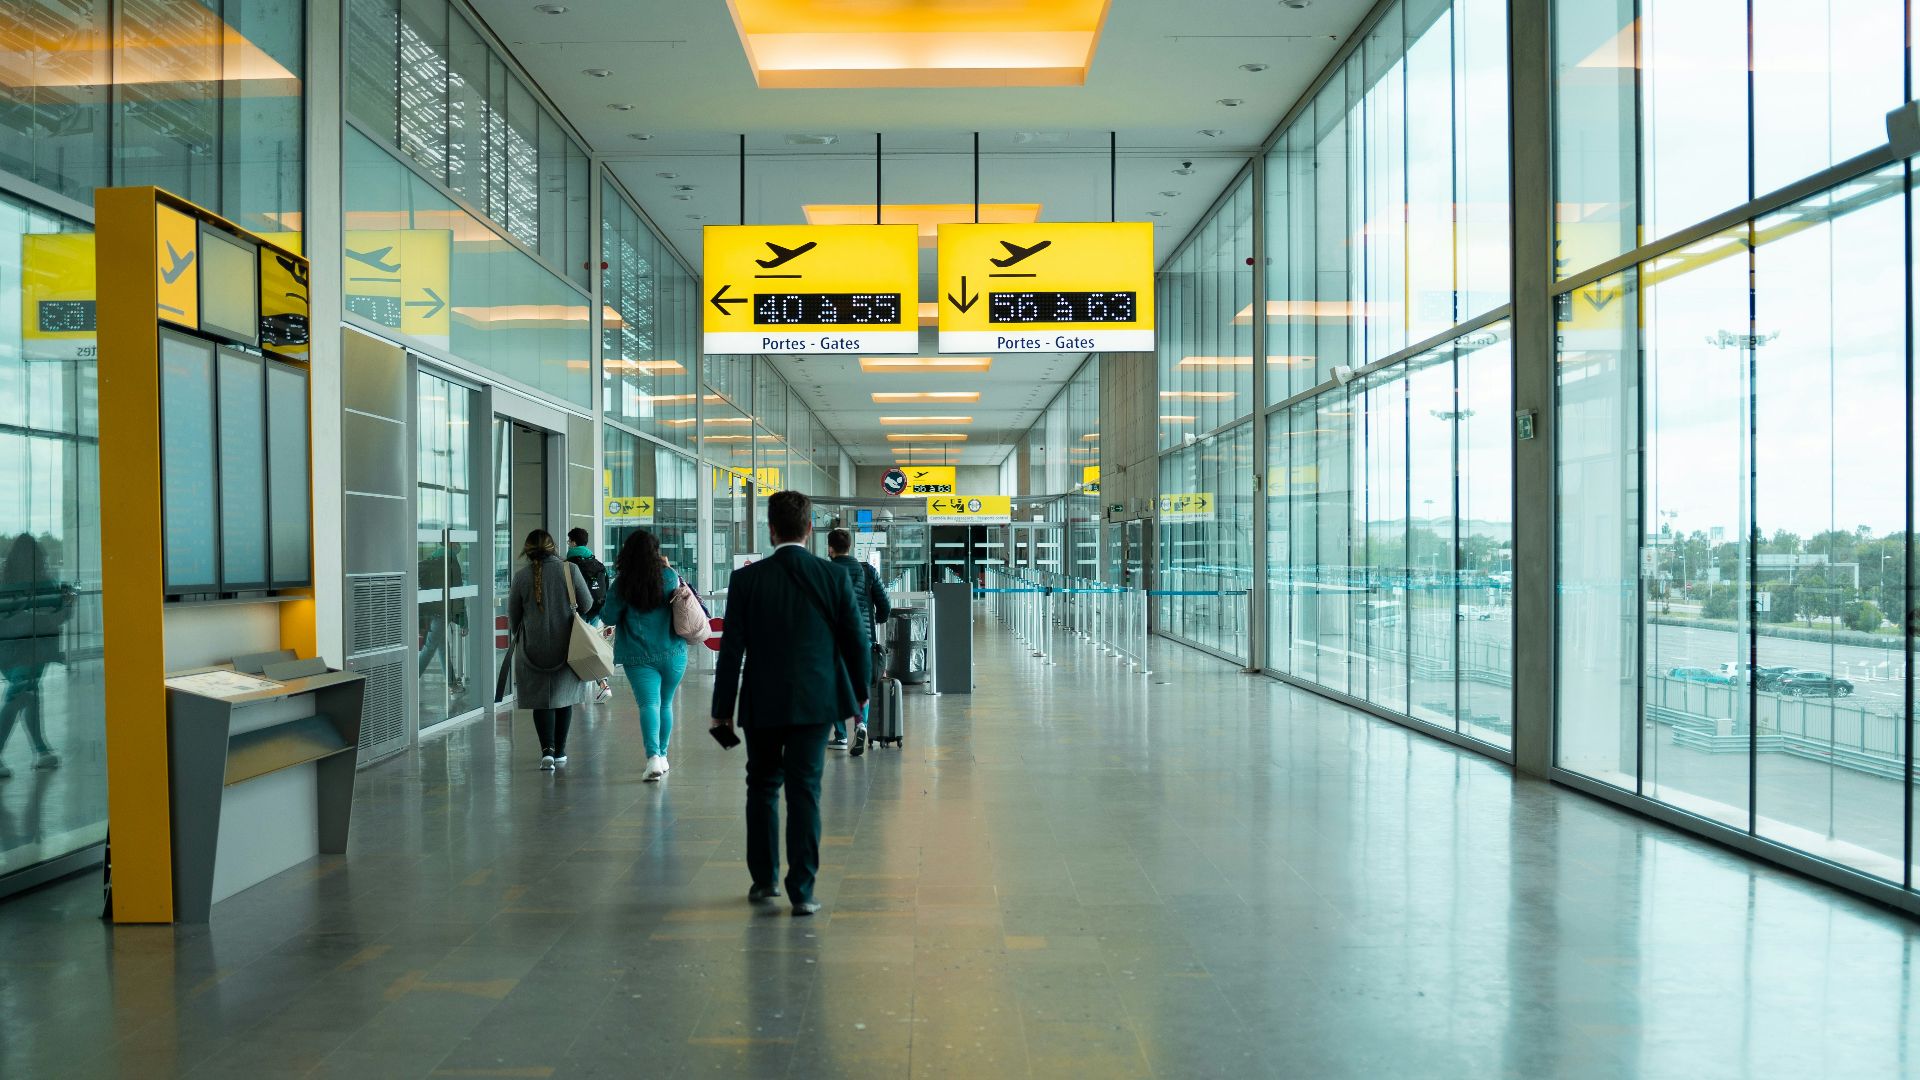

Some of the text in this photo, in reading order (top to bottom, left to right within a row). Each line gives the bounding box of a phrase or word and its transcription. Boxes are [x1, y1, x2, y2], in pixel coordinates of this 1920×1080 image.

[759, 295, 895, 323] 40 à 55
[994, 293, 1131, 321] 56 à 63
[762, 337, 806, 350] Portes
[820, 337, 860, 350] Gates
[997, 336, 1041, 349] Portes
[1055, 336, 1095, 349] Gates
[914, 485, 927, 493] 56
